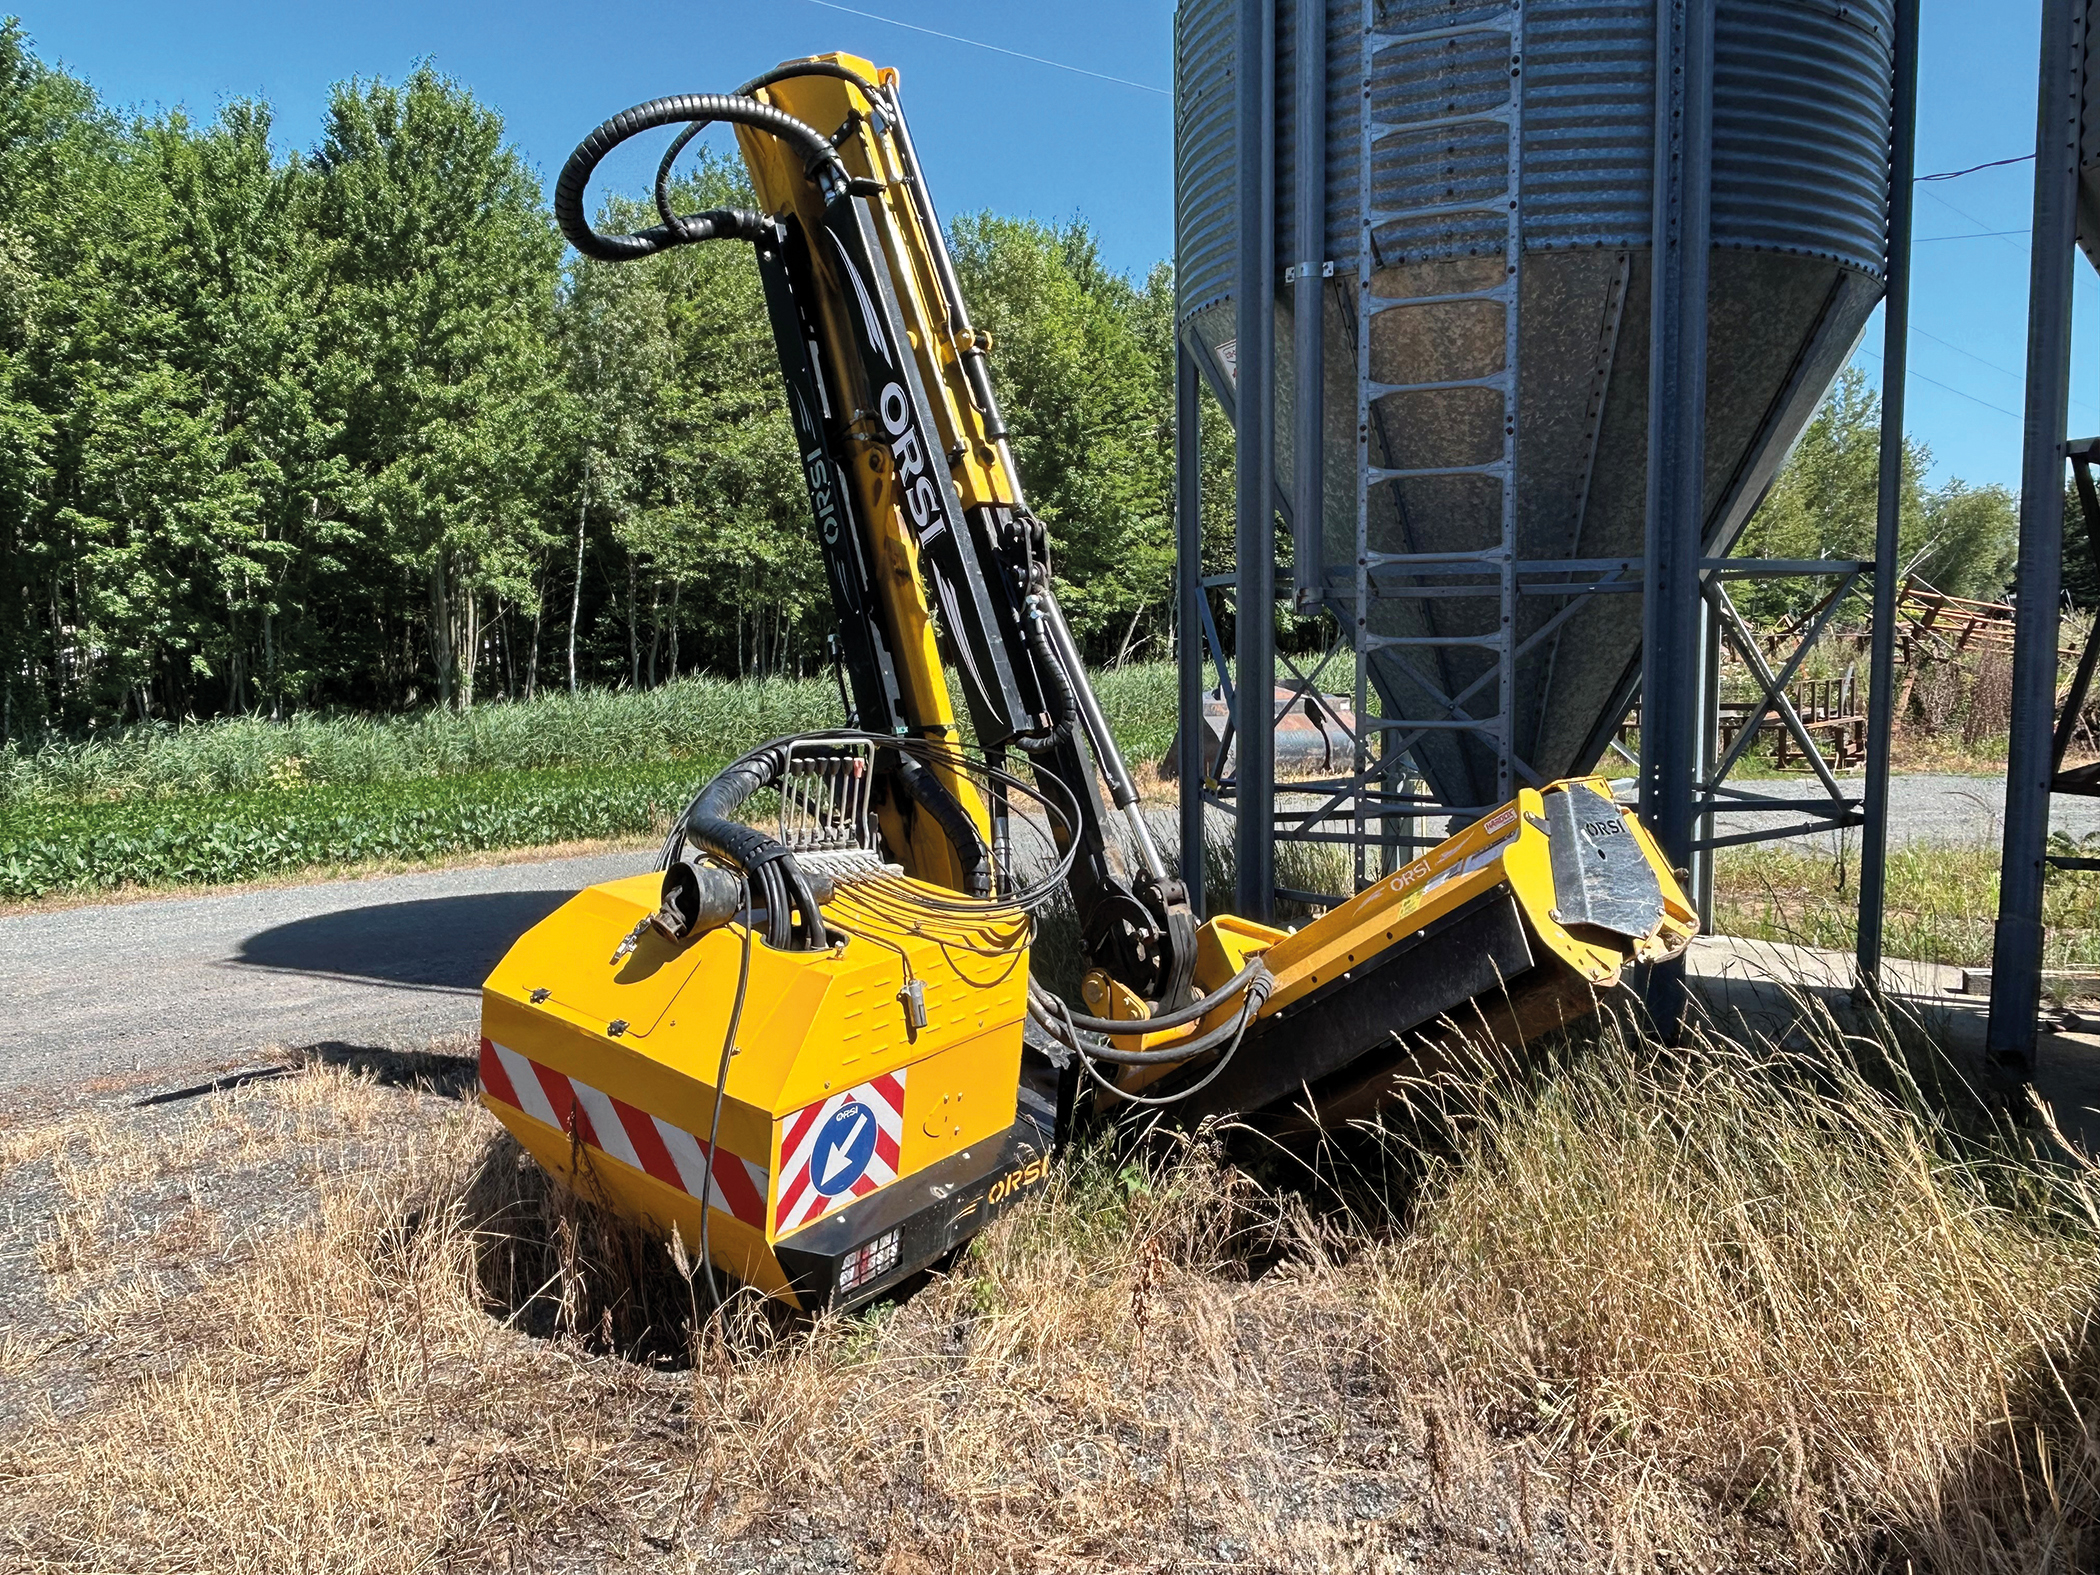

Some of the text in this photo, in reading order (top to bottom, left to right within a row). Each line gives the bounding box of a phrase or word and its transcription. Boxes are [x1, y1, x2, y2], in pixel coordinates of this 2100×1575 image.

[880, 382, 947, 549] ORSI
[807, 448, 838, 545] ORSI
[1585, 819, 1626, 837] ORSI
[1390, 859, 1432, 891] ORSI
[836, 1105, 858, 1121] ORSI
[988, 1154, 1050, 1204] ORSI
